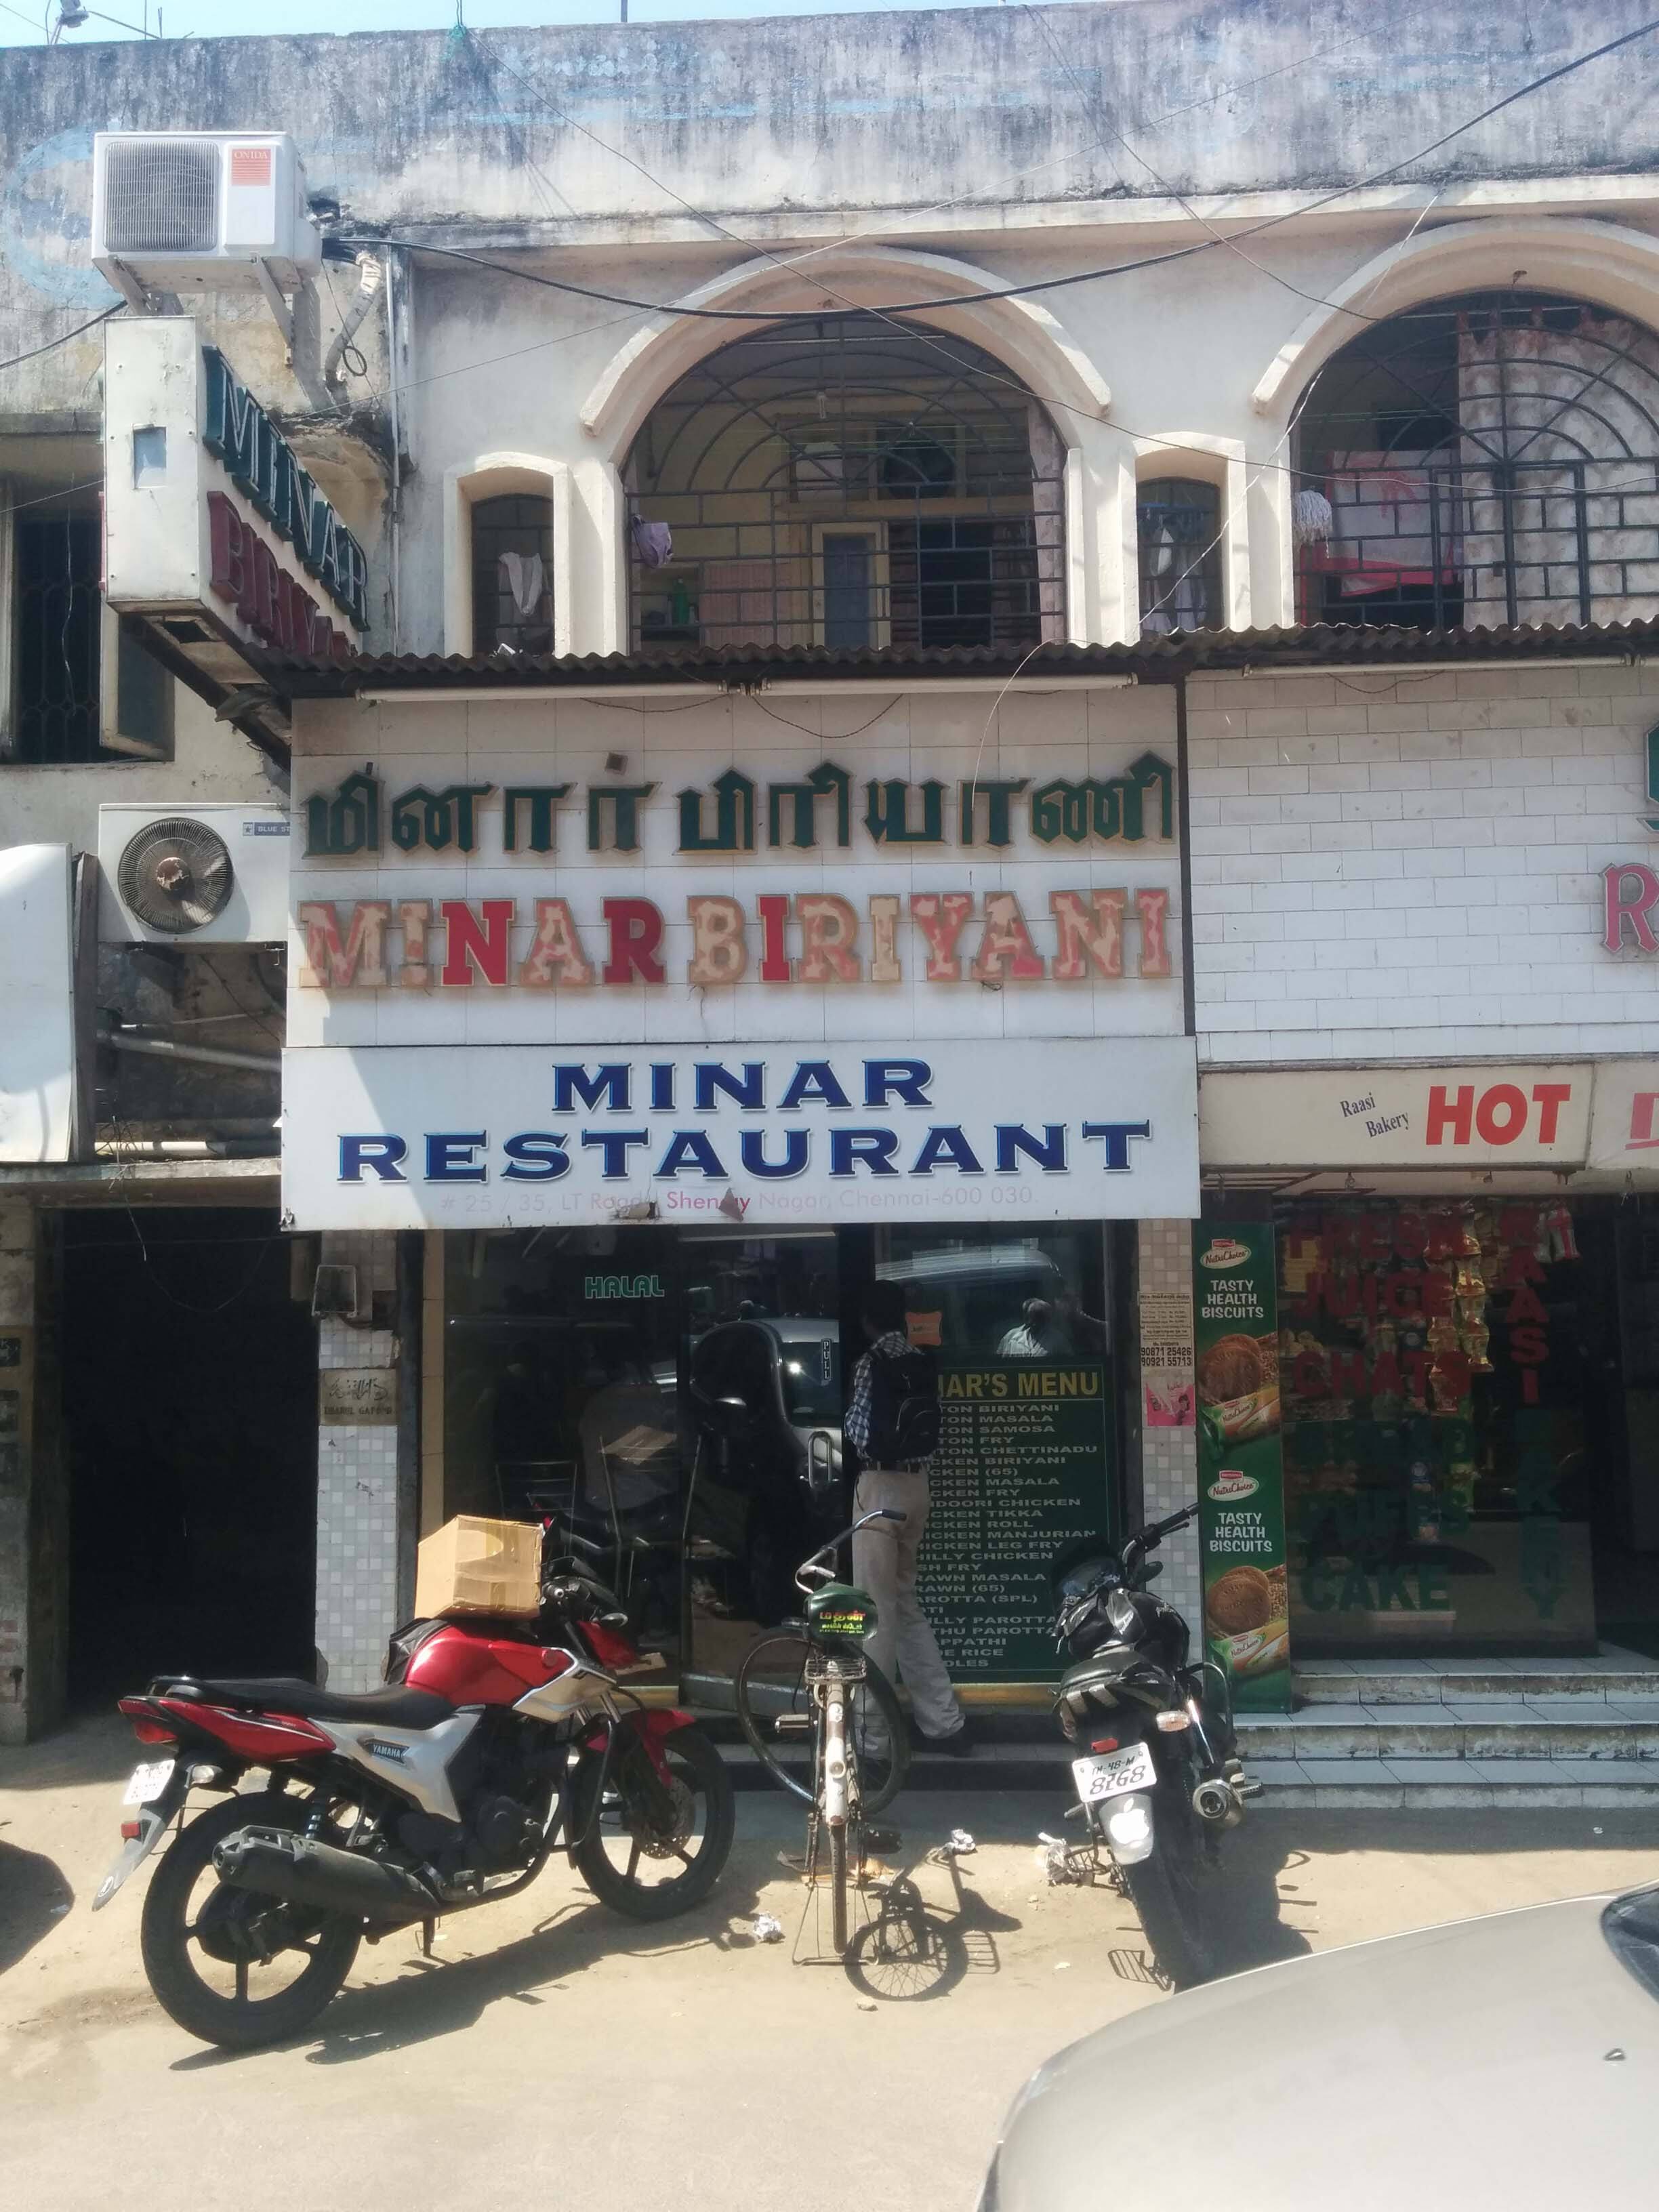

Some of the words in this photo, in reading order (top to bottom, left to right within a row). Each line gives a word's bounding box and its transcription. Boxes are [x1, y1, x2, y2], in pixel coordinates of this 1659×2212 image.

[202, 344, 370, 632] MINAR
[301, 752, 662, 859] மினார்
[672, 750, 1176, 856] பிரியாணி
[299, 896, 666, 988] MINAR
[687, 887, 1172, 986] BIRIYANI
[552, 1058, 934, 1113] MINAR
[1339, 1091, 1376, 1118] Raasi
[1425, 1084, 1572, 1145] HOT
[1365, 1111, 1410, 1138] Bakery
[336, 1119, 1151, 1183] RESTAURANT
[667, 1191, 751, 1213] Sheny
[585, 1275, 665, 1299] HALAL
[1210, 1279, 1254, 1292] TASTY
[1207, 1293, 1257, 1305] HEALTH
[1202, 1307, 1264, 1318] BISCUITS
[1018, 1372, 1098, 1397] MENU
[979, 1404, 1060, 1412] BIRIYANI
[979, 1425, 1055, 1433] SAMOSA
[980, 1436, 1015, 1444] FRY
[980, 1446, 1098, 1454] CHETTINADU
[985, 1456, 1066, 1465] BIRIYANI
[929, 1468, 979, 1476] CKEN
[985, 1468, 1019, 1476] (65)
[998, 1498, 1081, 1507] CHICKEN
[987, 1509, 1043, 1517] TIKKA
[1218, 1513, 1262, 1524] TASTY
[987, 1520, 1033, 1528] ROLL
[987, 1530, 1097, 1538] MANJURIAN
[1215, 1526, 1265, 1538] HEALTH
[988, 1541, 1023, 1549] LEG
[1029, 1540, 1063, 1549] FRY
[1210, 1540, 1273, 1553] BISCUITS
[970, 1552, 1053, 1560] CHICKEN
[972, 1573, 1046, 1581] MASALA
[916, 1584, 966, 1593] RAWN
[972, 1584, 1005, 1593] (65)
[1301, 1563, 1451, 1611] CAKE
[991, 1595, 1038, 1604] (SPL)
[973, 1616, 1056, 1624] PAROTTA
[962, 1648, 1004, 1656] RICE
[373, 1744, 401, 1758] YAMAHA
